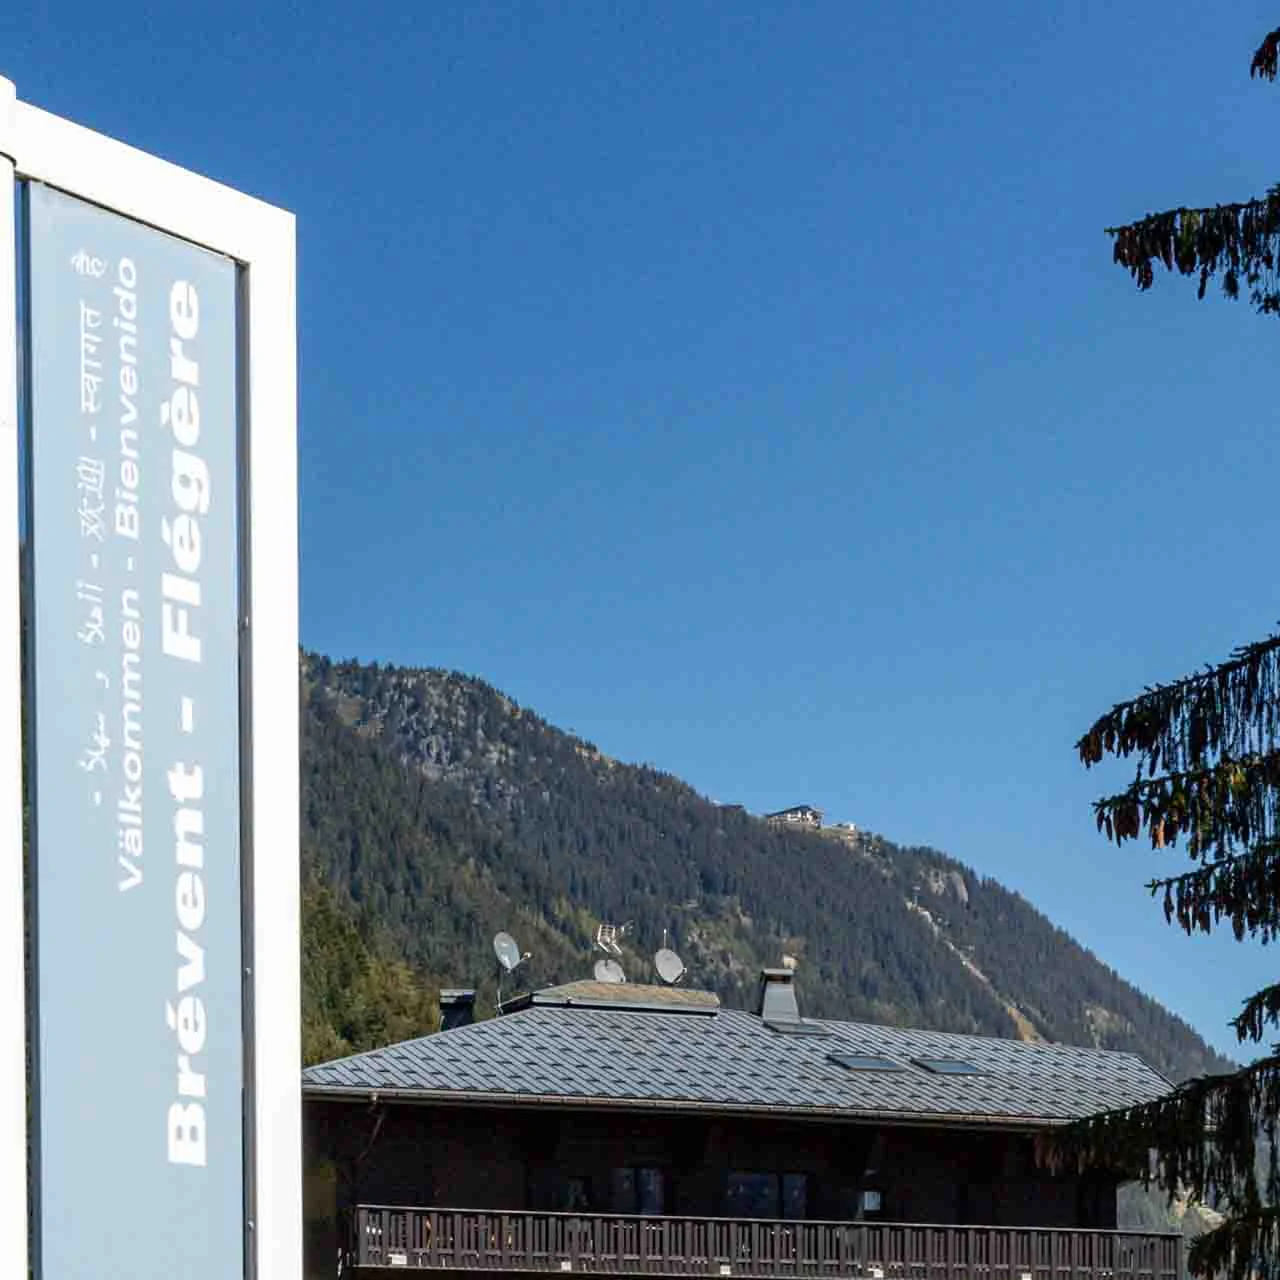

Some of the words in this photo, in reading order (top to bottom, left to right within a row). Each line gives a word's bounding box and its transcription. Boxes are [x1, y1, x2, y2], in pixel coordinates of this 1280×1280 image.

[75, 455, 106, 542] 欢迎
[79, 299, 104, 415] स्वागत
[112, 256, 140, 540] Bienvenido
[159, 280, 211, 664] Flégère
[116, 588, 145, 893] Välkommen
[165, 759, 209, 1168] Brévent
